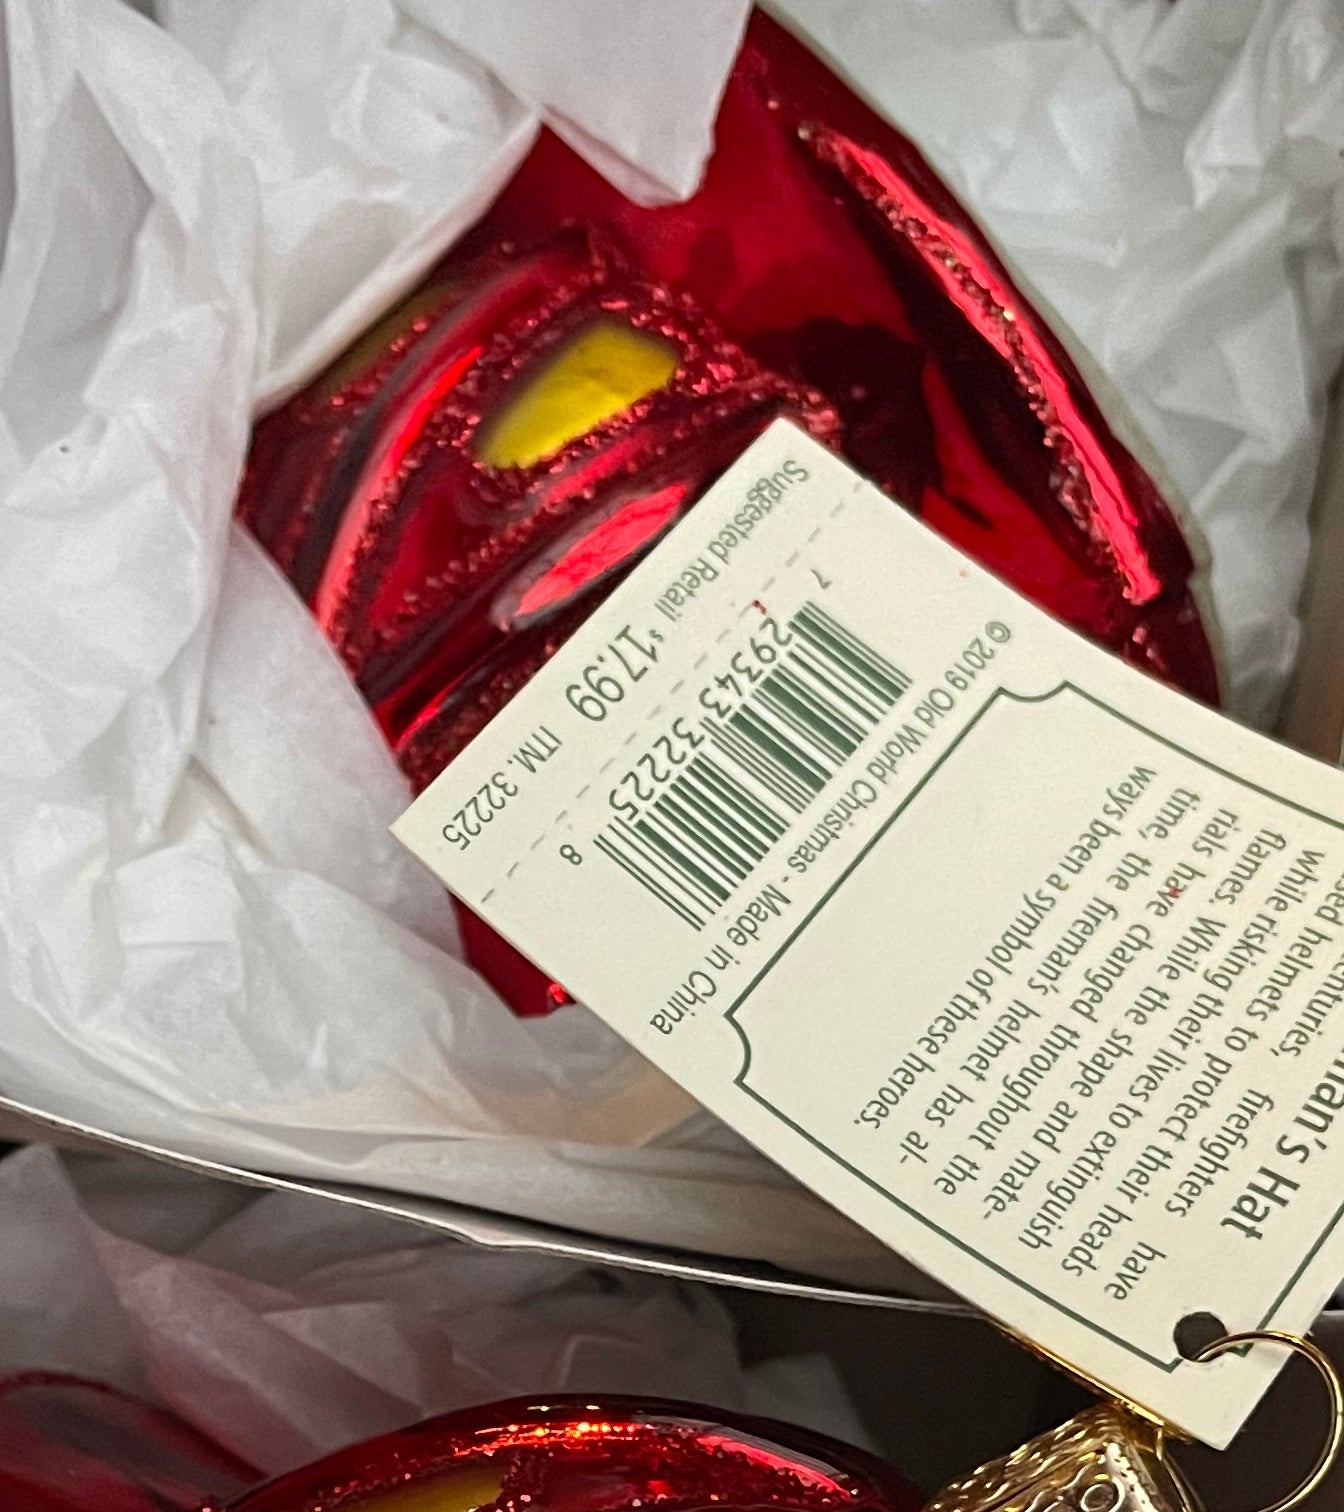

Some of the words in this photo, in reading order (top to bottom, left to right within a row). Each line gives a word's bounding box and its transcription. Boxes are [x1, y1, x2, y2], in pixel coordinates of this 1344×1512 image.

[707, 460, 809, 565] Suggested
[654, 557, 720, 622] Retail
[808, 567, 832, 590] 7
[564, 622, 668, 723] $17.99
[698, 616, 795, 718] 29343
[944, 637, 995, 691] 2019
[913, 688, 955, 729] Old
[506, 725, 563, 774] ITM.
[608, 716, 706, 822] 32225
[866, 724, 928, 785] World
[442, 771, 519, 851] 32225
[1102, 766, 1157, 821] ways
[1138, 788, 1201, 839] time,
[559, 843, 583, 866] 8
[787, 779, 878, 874] Christmas
[1059, 818, 1122, 875] been
[1192, 808, 1240, 857] rials
[1045, 873, 1070, 892] a
[1106, 852, 1153, 891] the
[1145, 862, 1207, 918] have
[1208, 829, 1287, 905] flames.
[1265, 850, 1325, 912] while
[726, 883, 792, 947] Made
[985, 889, 1057, 976] symbol
[1027, 896, 1119, 996] fireman's
[704, 944, 741, 971] in
[1069, 923, 1154, 1024] changed
[1157, 916, 1227, 981] While
[1202, 913, 1278, 993] risking
[1245, 926, 1334, 1022] helmets
[649, 970, 718, 1035] China
[965, 968, 994, 1004] of
[1124, 985, 1171, 1026] the
[916, 993, 980, 1055] these
[959, 999, 1041, 1082] helmet
[1168, 992, 1225, 1051] their
[1224, 1026, 1260, 1052] to
[853, 1052, 936, 1130] heroes.
[968, 1023, 1081, 1151] throughout
[1069, 1028, 1134, 1098] shape
[1128, 1047, 1187, 1103] lives
[924, 1083, 975, 1128] has
[1032, 1100, 1079, 1154] and
[1108, 1102, 1144, 1129] to
[1158, 1051, 1233, 1142] protect
[899, 1130, 929, 1164] al-
[933, 1153, 981, 1196] the
[1116, 1144, 1174, 1205] their
[1164, 1088, 1275, 1218] firefighters
[983, 1149, 1042, 1220] mate-
[1017, 1130, 1118, 1250] extinguish
[1219, 1165, 1301, 1241] Hat
[1060, 1203, 1134, 1277] heads
[1103, 1241, 1167, 1301] have
